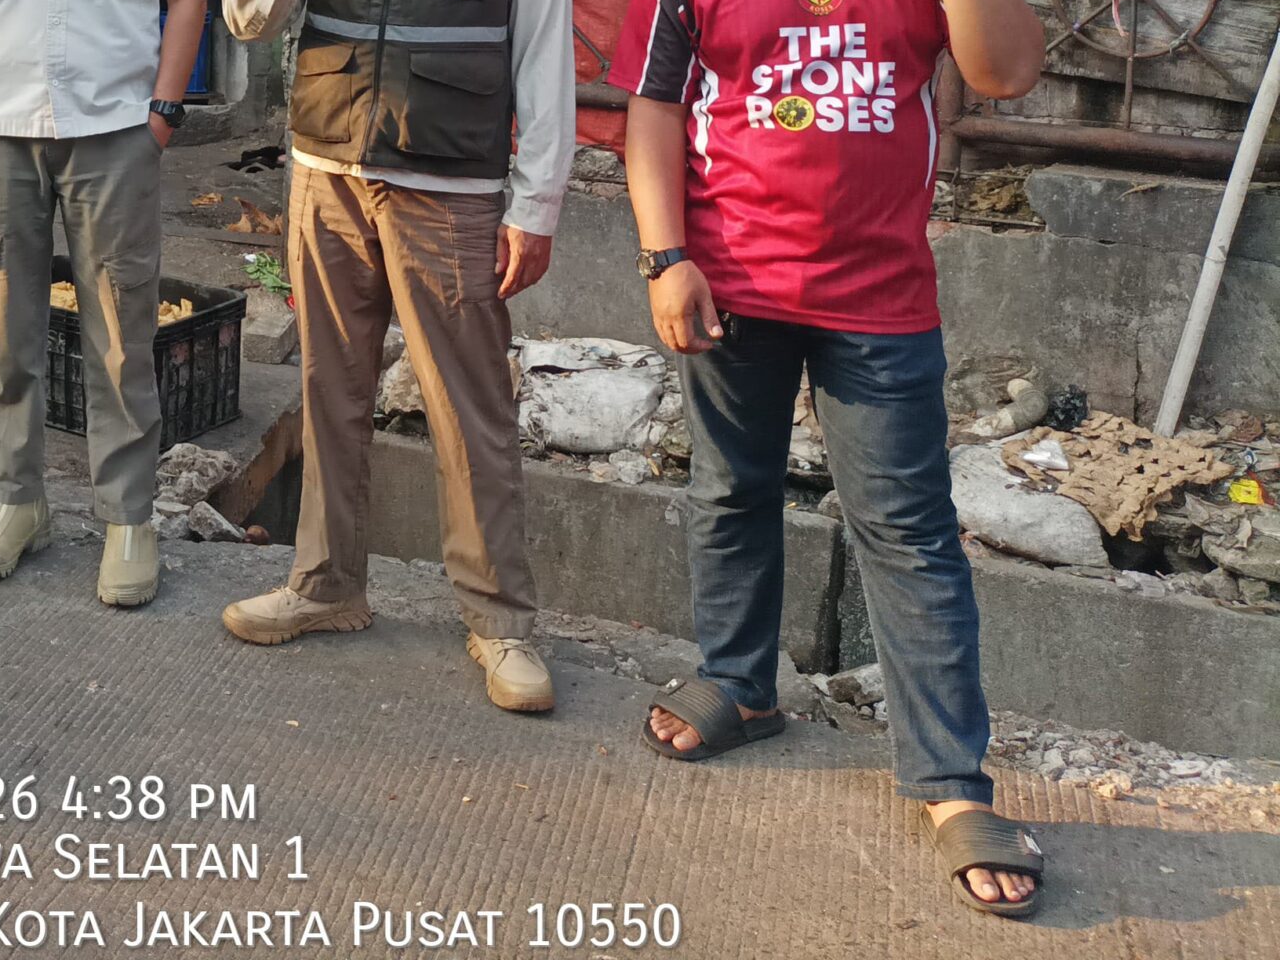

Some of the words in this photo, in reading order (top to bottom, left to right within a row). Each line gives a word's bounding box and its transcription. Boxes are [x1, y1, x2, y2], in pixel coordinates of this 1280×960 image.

[779, 23, 867, 61] THE
[752, 60, 896, 96] STONE
[745, 95, 896, 133] ROSES
